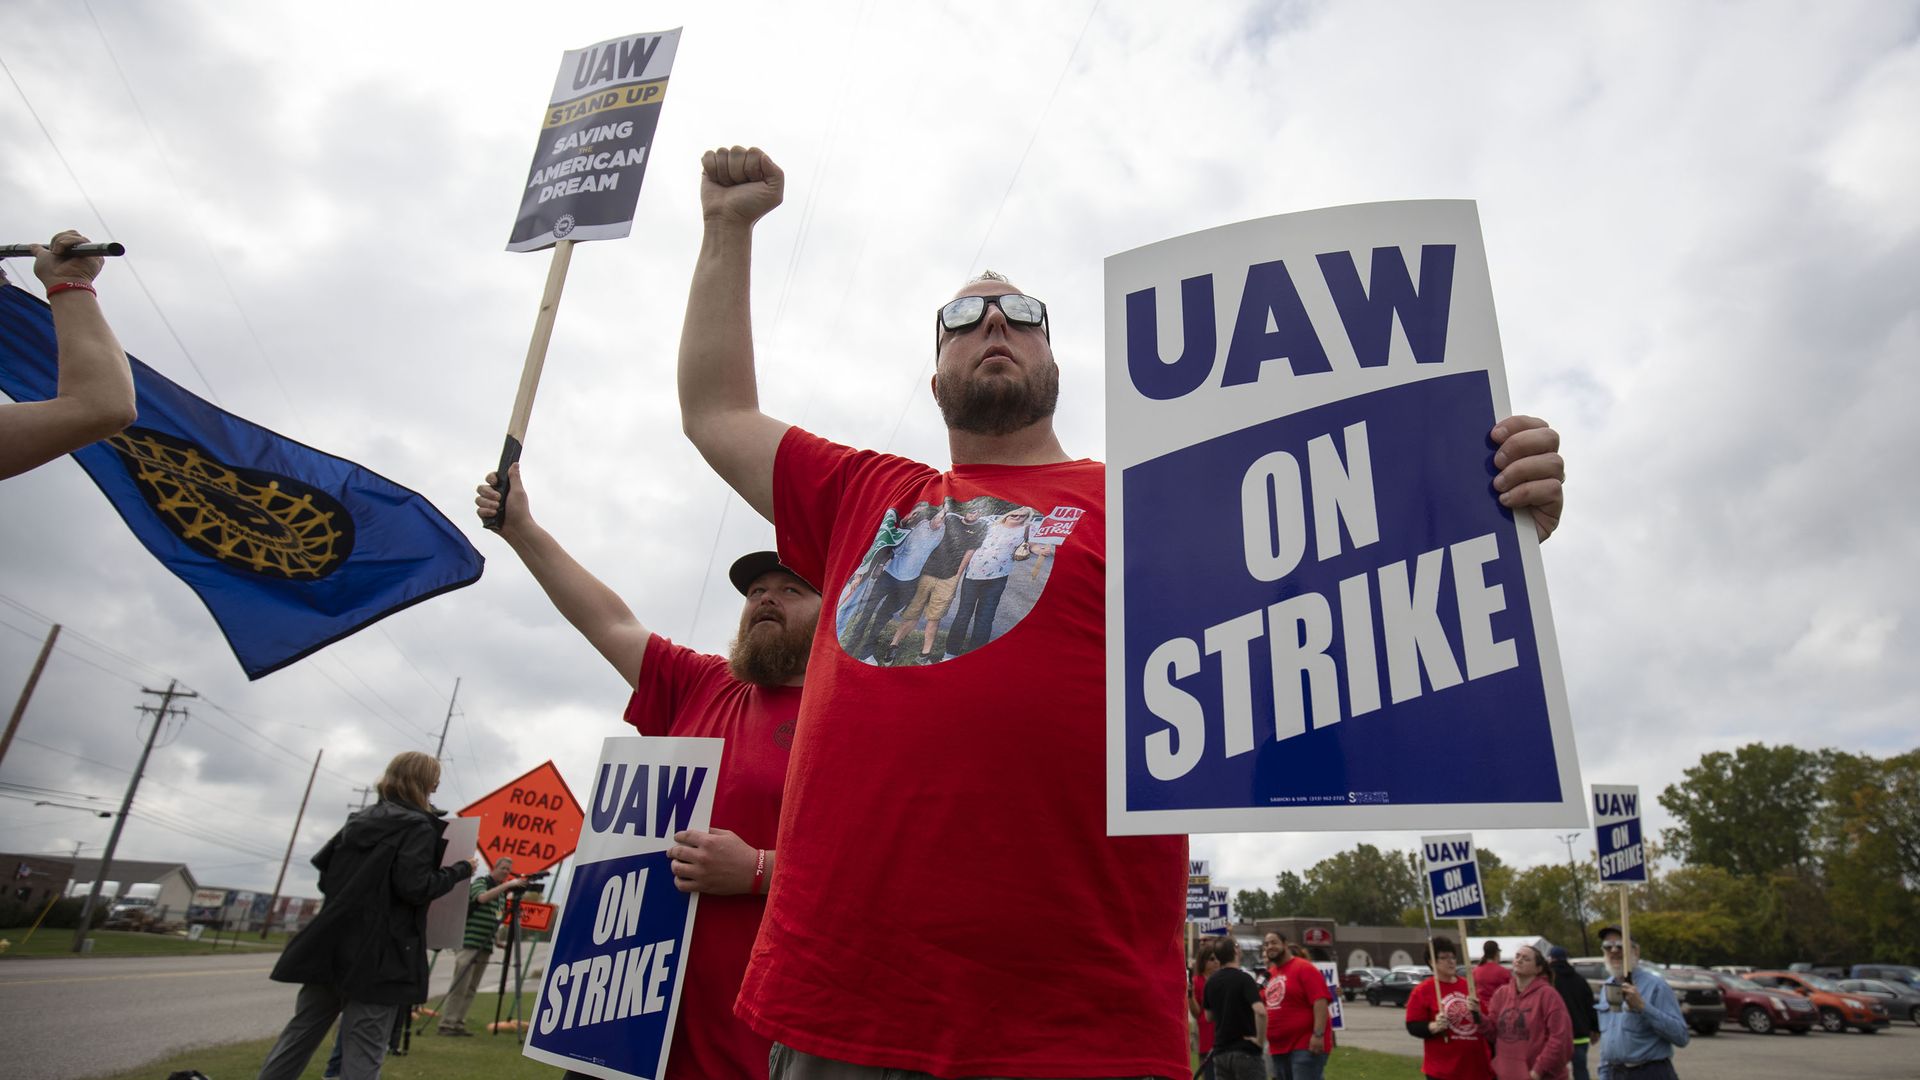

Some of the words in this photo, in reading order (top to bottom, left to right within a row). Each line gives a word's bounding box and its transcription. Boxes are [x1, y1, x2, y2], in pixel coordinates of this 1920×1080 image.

[572, 36, 662, 91] UAW
[549, 92, 619, 125] STAND
[626, 85, 659, 103] UP
[552, 121, 634, 155] SAVING
[528, 146, 646, 188] AMERICAN
[538, 172, 620, 204] DREAM
[1126, 244, 1456, 400] UAW
[1241, 420, 1380, 583] ON
[1143, 532, 1519, 781] STRIKE
[509, 788, 563, 811] ROAD
[591, 763, 708, 839] UAW
[1595, 793, 1636, 816] UAW
[502, 811, 557, 835] WORK
[1612, 824, 1629, 850] ON
[487, 835, 556, 860] AHEAD
[1425, 841, 1470, 863] UAW
[1601, 843, 1642, 878] STRIKE
[1443, 868, 1463, 890] ON
[592, 867, 649, 945] ON
[1210, 891, 1227, 902] AW
[1435, 884, 1480, 915] STRIKE
[540, 939, 675, 1035] STRIKE
